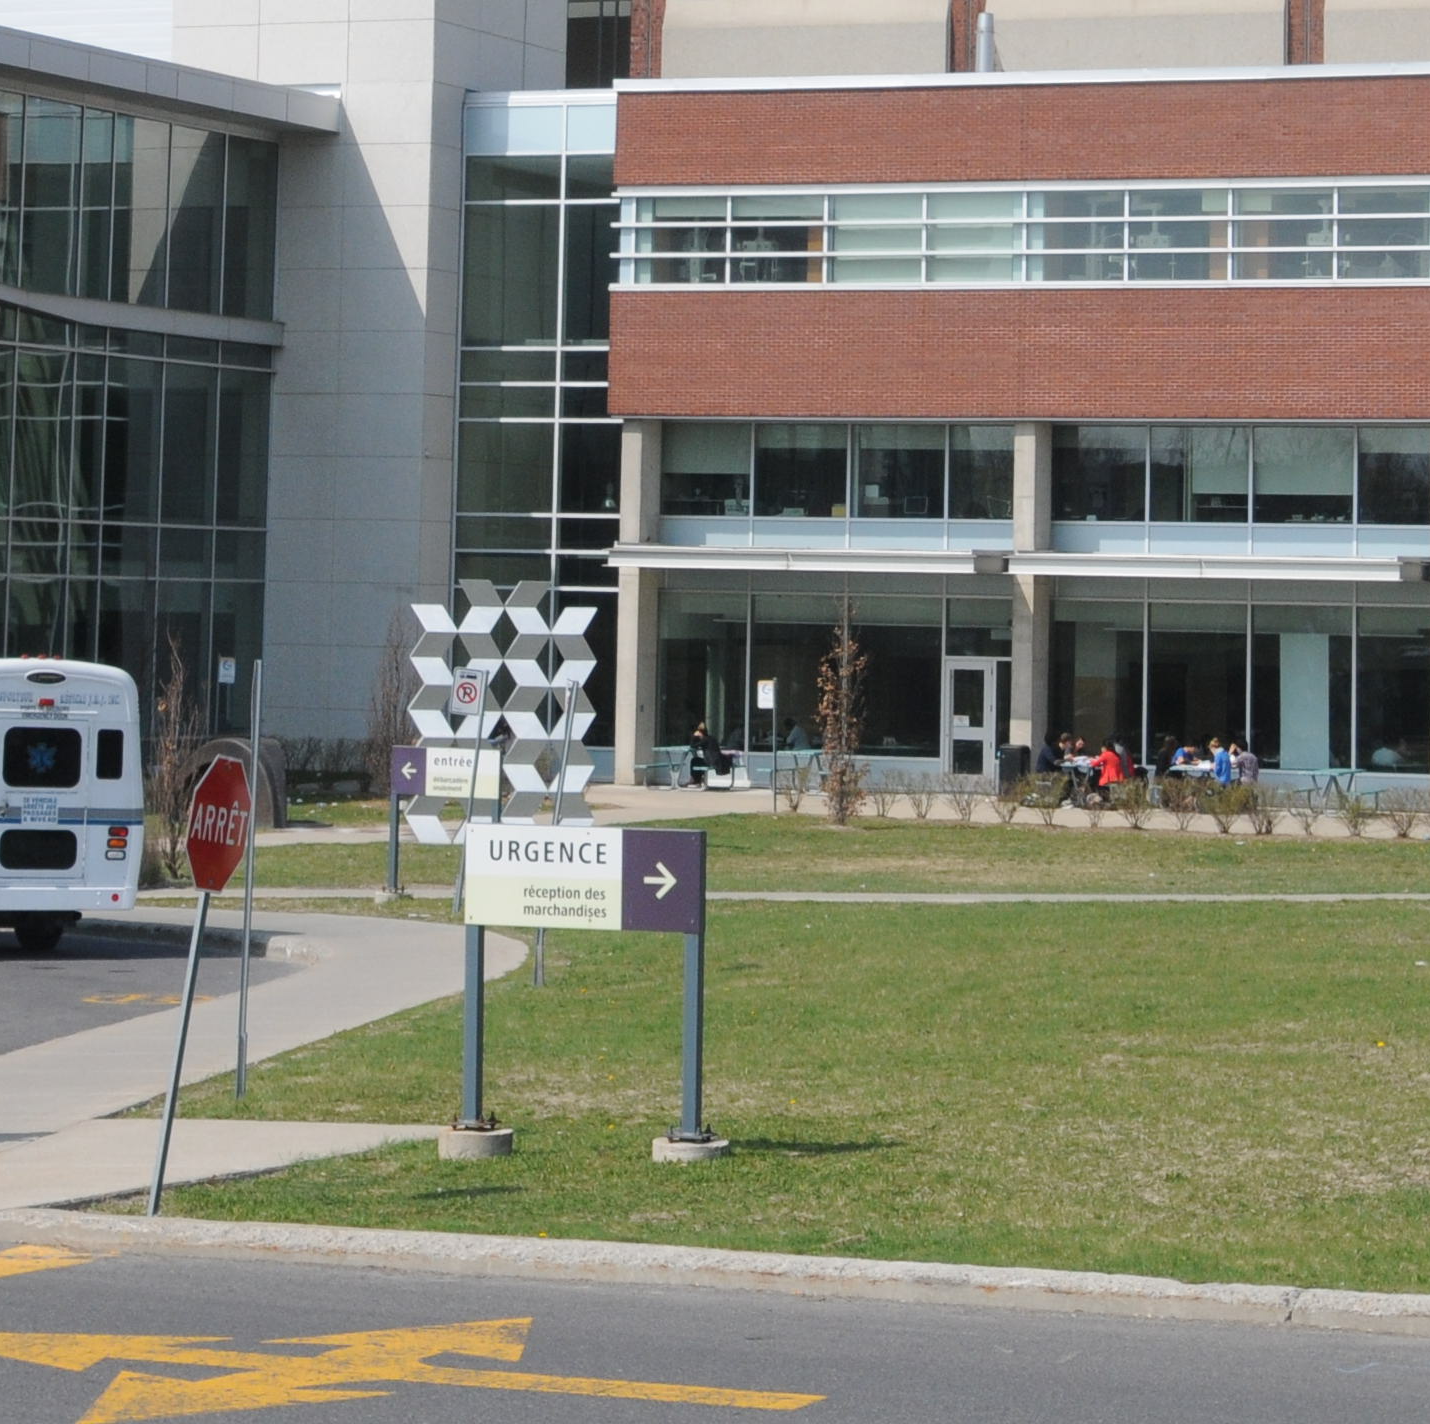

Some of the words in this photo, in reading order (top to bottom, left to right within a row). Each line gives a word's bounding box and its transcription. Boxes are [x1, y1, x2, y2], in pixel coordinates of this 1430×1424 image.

[433, 755, 473, 768] entrée
[190, 799, 248, 847] ARRÊT
[489, 839, 607, 865] URGENCE
[523, 884, 581, 902] réception
[584, 886, 606, 901] des
[523, 903, 607, 919] marchandises
